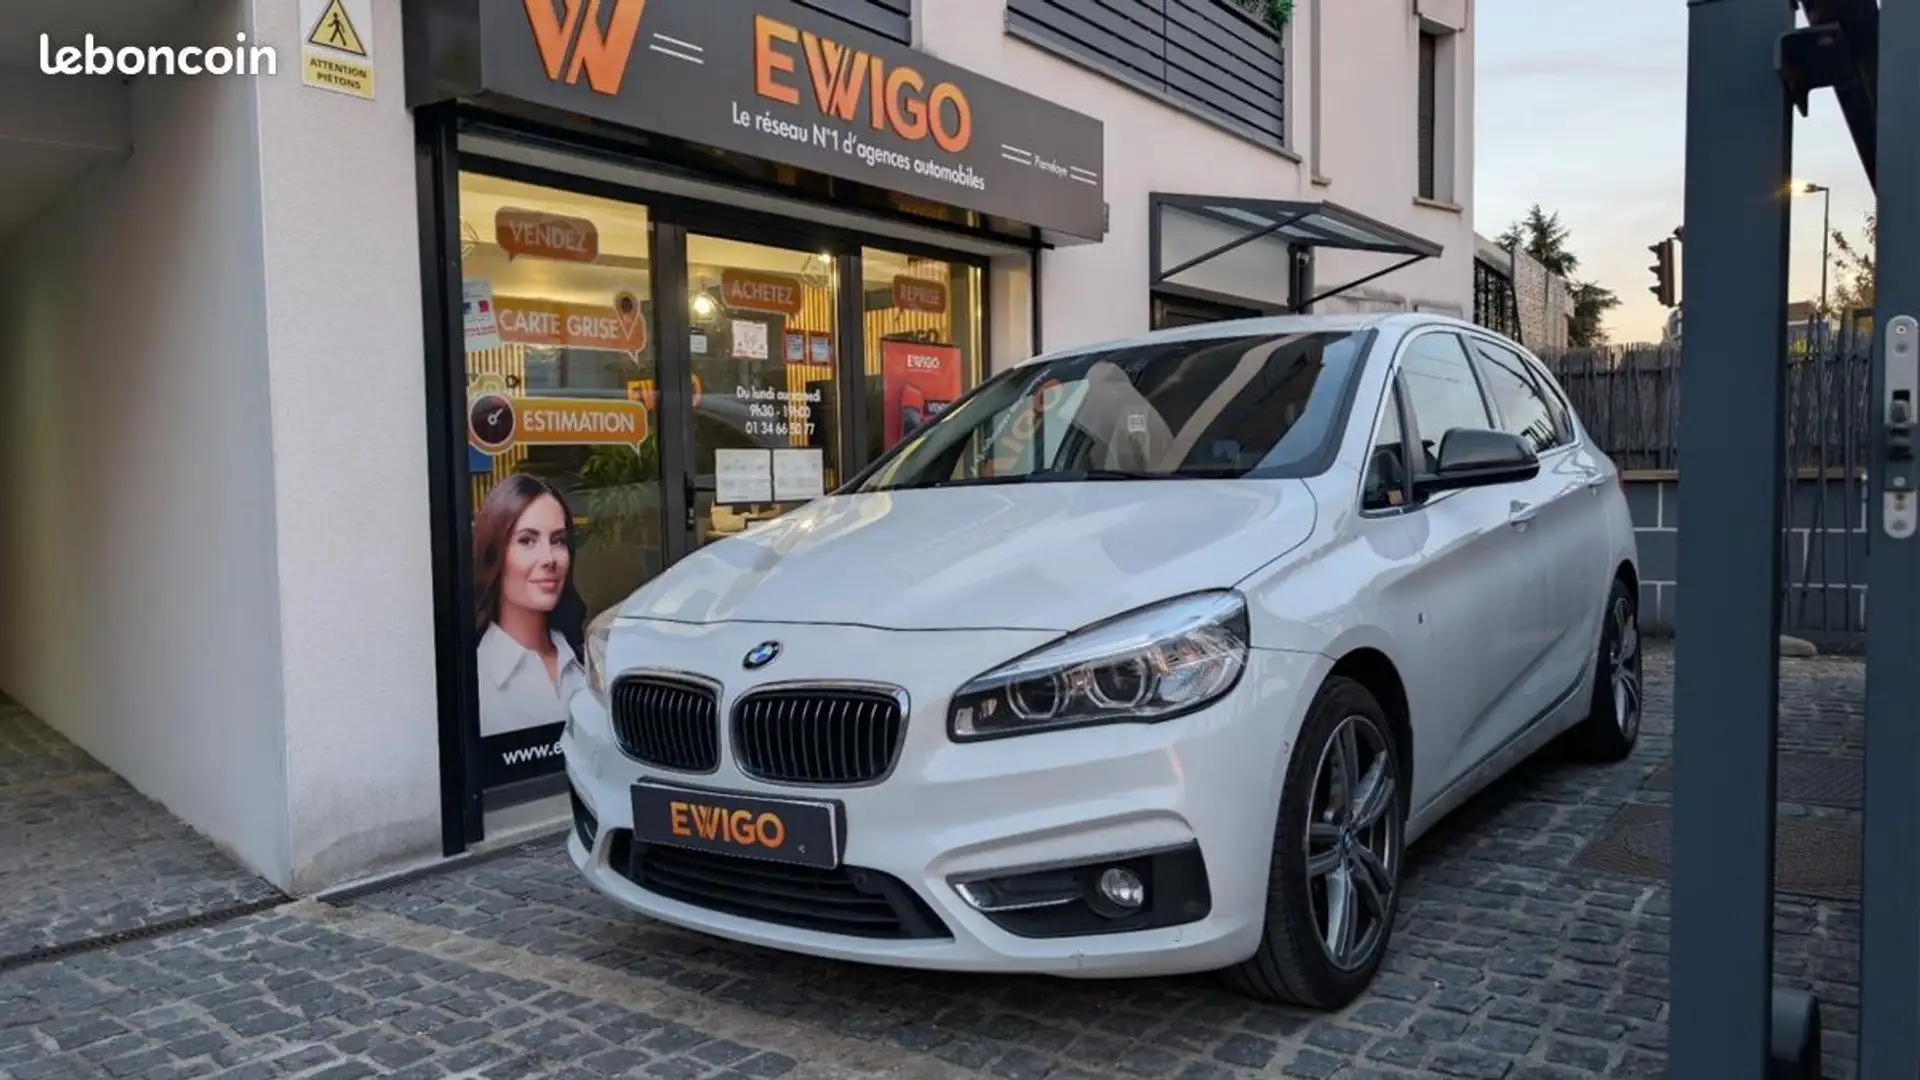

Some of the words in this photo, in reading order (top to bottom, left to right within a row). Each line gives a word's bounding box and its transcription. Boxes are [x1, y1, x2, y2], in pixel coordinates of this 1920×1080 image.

[309, 58, 367, 78] ATTENTION
[755, 15, 971, 153] EWIGO
[732, 101, 750, 127] Le
[756, 111, 808, 143] réseau
[914, 158, 985, 190] automobiles
[510, 220, 588, 251] VENDEZ
[732, 280, 793, 305] ACHETEZ
[500, 309, 561, 335] CARTE
[567, 317, 619, 338] GRISE
[907, 354, 940, 369] EWIGO
[737, 385, 750, 399] Du
[752, 385, 775, 400] lundi
[523, 411, 635, 434] ESTIMATION
[749, 404, 774, 417] 9h30
[745, 421, 758, 435] 01
[761, 421, 774, 435] 34
[776, 421, 788, 435] 66
[804, 422, 816, 435] 77
[669, 801, 786, 848] EWIGO
